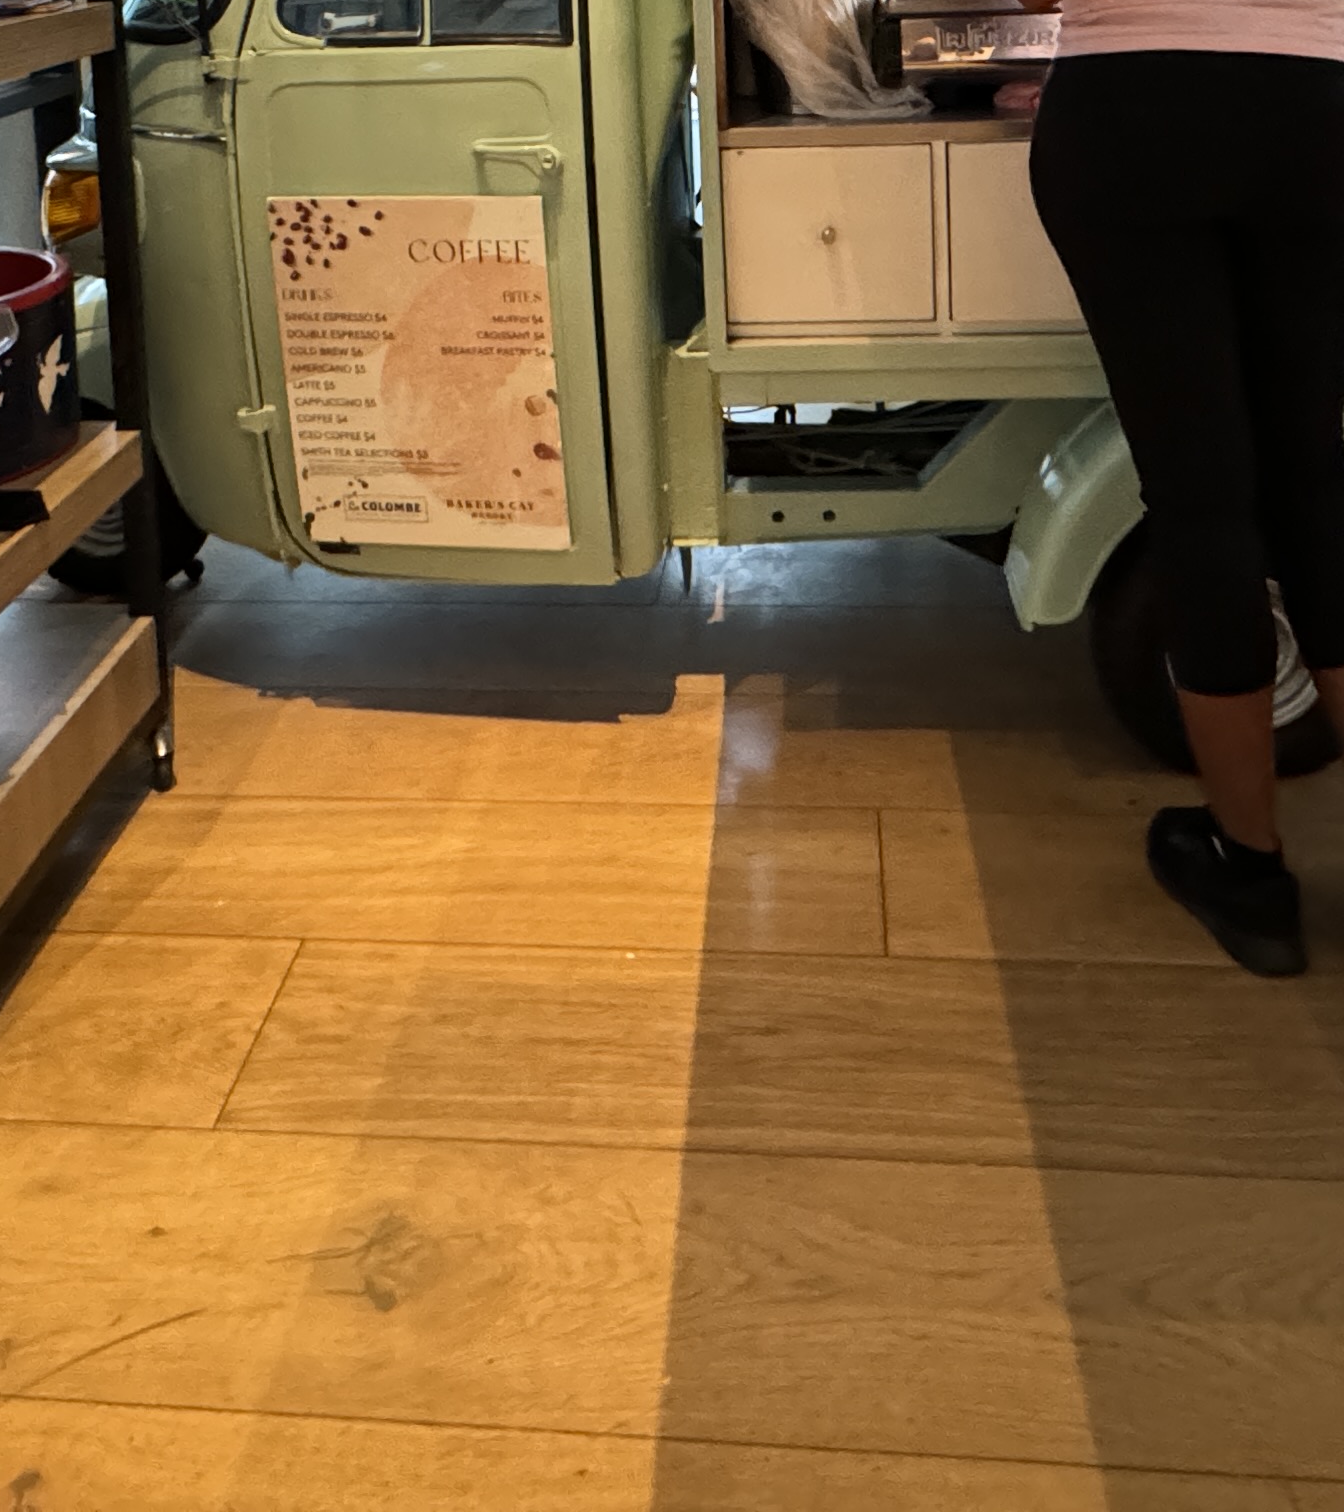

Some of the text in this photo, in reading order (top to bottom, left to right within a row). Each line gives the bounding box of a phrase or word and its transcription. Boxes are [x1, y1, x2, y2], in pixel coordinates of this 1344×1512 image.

[408, 238, 531, 264] COFFEE
[323, 312, 373, 322] ESPRESSO
[287, 329, 327, 339] DOUBLE
[330, 330, 380, 340] ESPRESSO
[288, 346, 317, 356] COLD
[319, 346, 348, 356] BREW
[290, 363, 352, 373] AMERICANO
[293, 380, 320, 390] LATTE
[294, 397, 362, 407] CAPPUCCINO
[296, 414, 333, 424] COFFEE
[324, 431, 361, 441] COFFEE
[333, 448, 351, 457] TEA
[361, 501, 422, 514] COLOMBE
[509, 501, 535, 511] CAY
